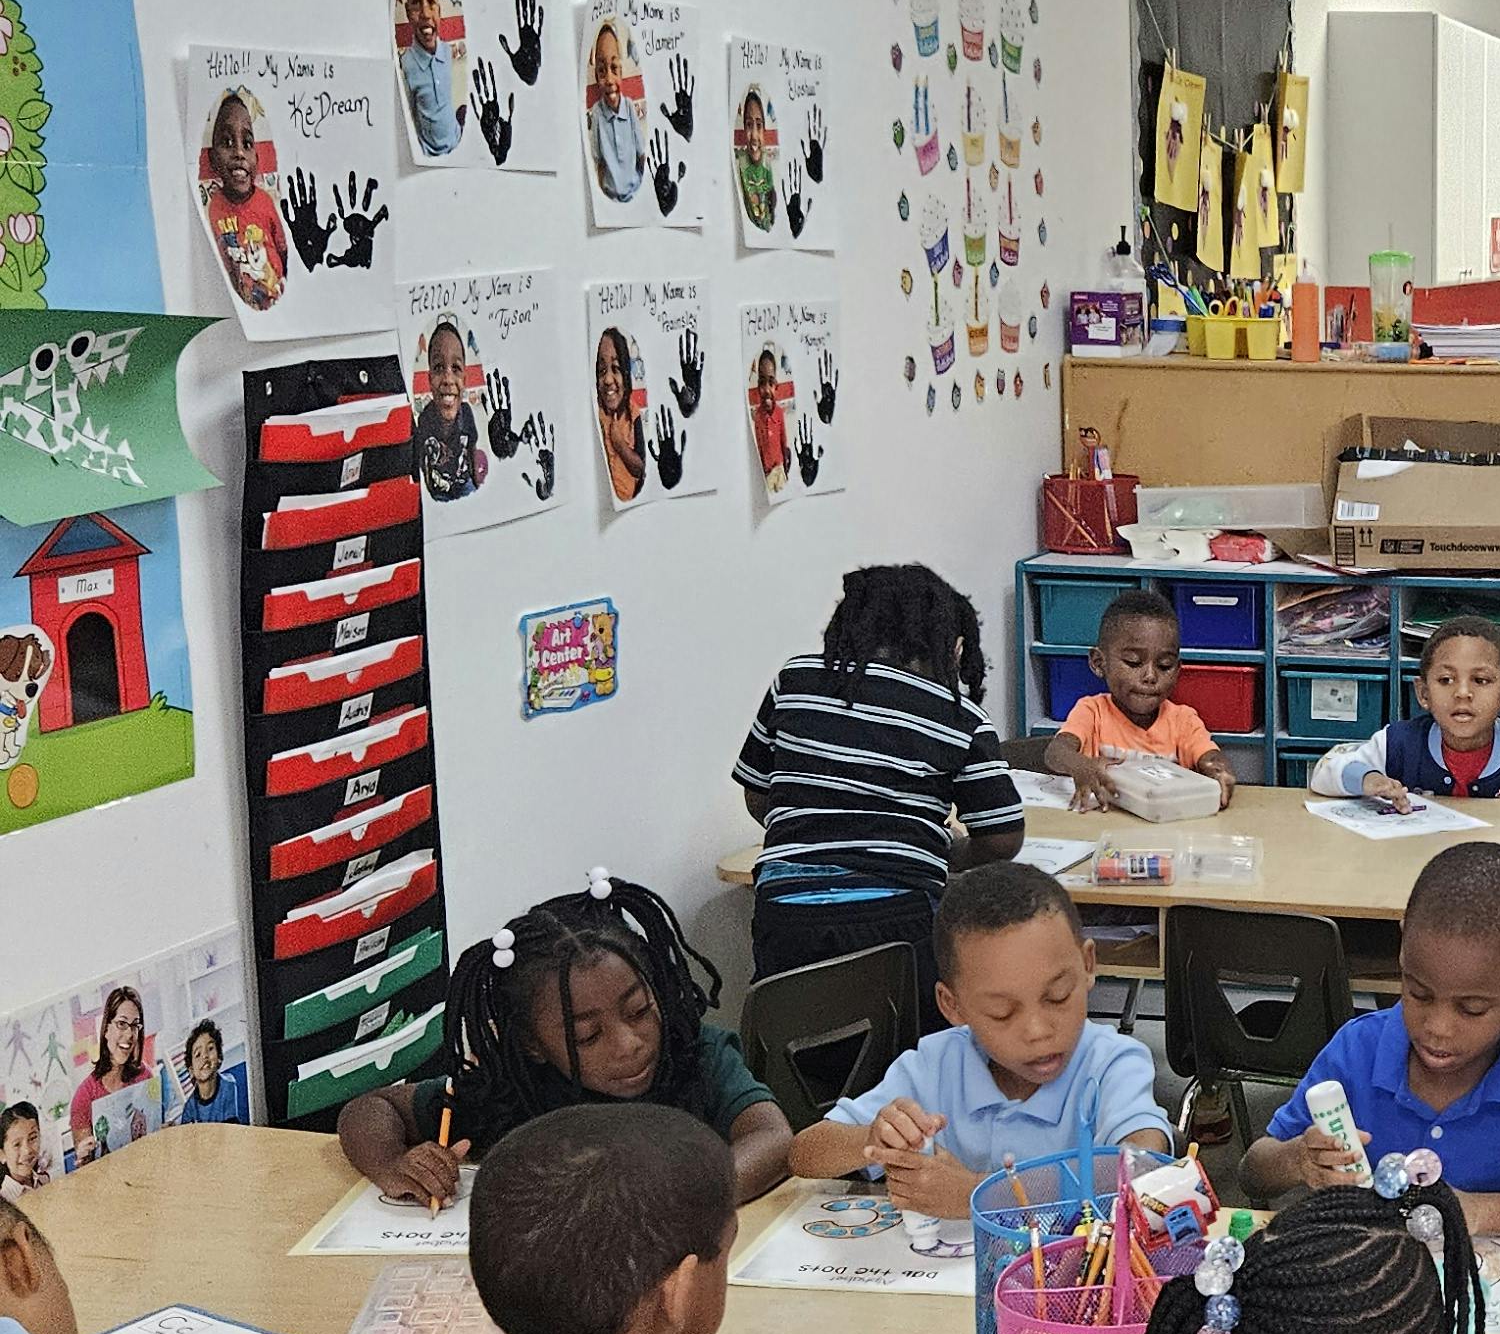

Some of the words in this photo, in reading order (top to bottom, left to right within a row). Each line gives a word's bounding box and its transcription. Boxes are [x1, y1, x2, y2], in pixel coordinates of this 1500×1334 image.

[258, 54, 279, 88] My
[285, 55, 315, 80] Name
[323, 61, 335, 79] is
[76, 579, 98, 593] Max
[552, 627, 571, 647] Art
[542, 646, 583, 668] Center
